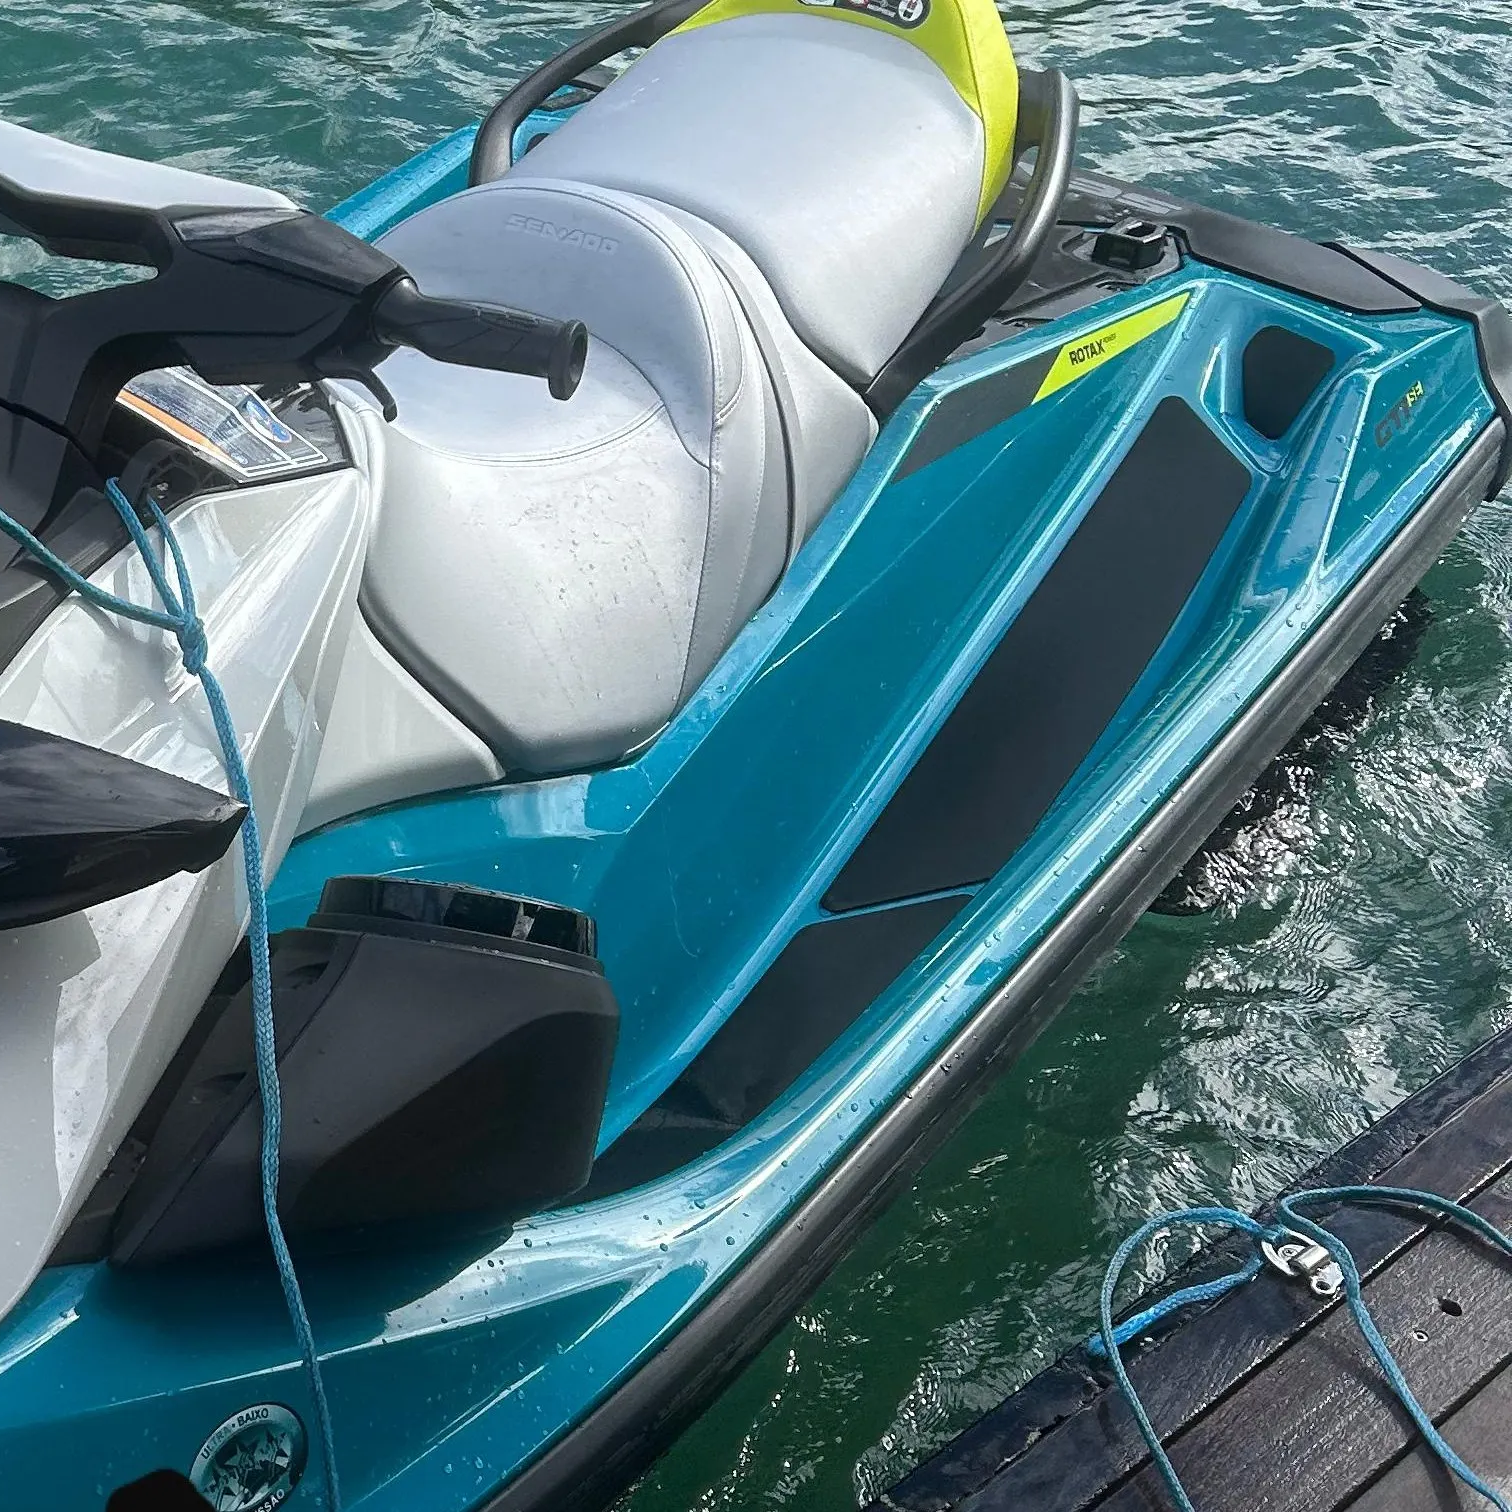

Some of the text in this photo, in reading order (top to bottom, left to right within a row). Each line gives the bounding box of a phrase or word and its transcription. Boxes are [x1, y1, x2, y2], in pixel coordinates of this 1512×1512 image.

[1069, 339, 1106, 366] ROTAX
[200, 1407, 269, 1460] ULTRA BAIXO
